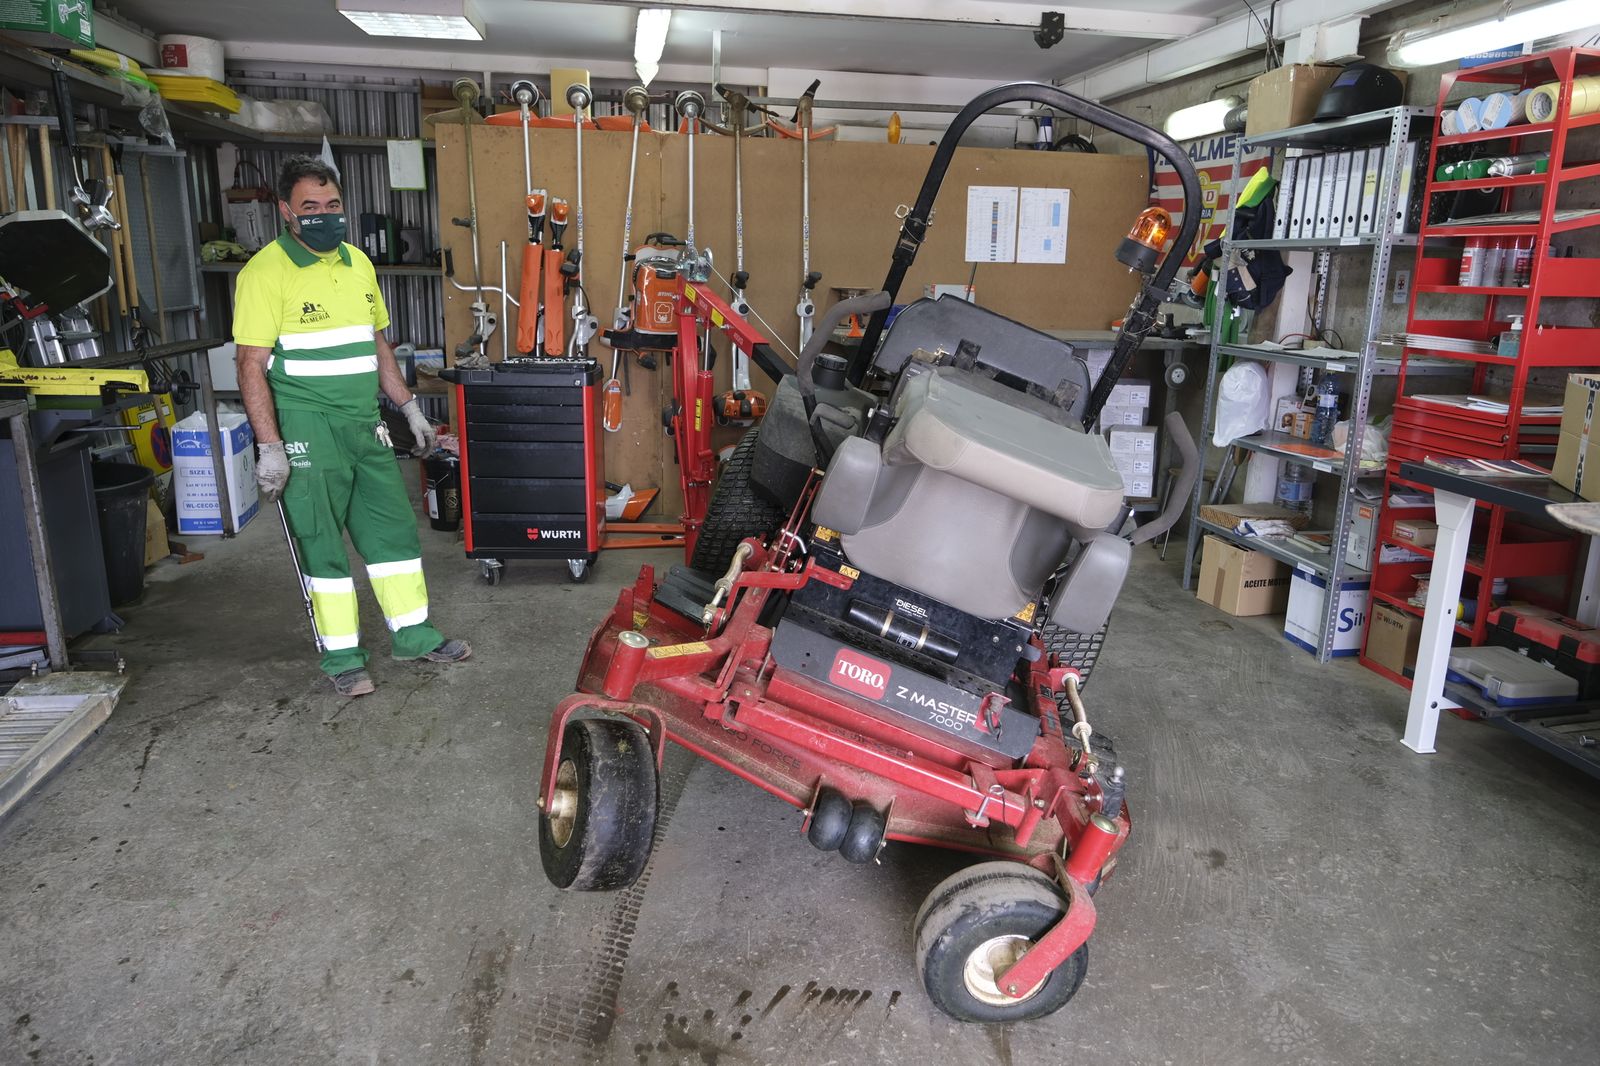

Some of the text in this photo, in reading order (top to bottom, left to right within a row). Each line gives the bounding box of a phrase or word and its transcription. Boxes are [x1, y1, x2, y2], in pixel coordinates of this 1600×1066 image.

[1244, 579, 1267, 588] ACEITE
[895, 598, 928, 618] DIESEL
[838, 659, 884, 689] TORO
[896, 685, 977, 725] Z MASTER
[928, 712, 963, 731] 7000
[752, 738, 801, 769] FORCE
